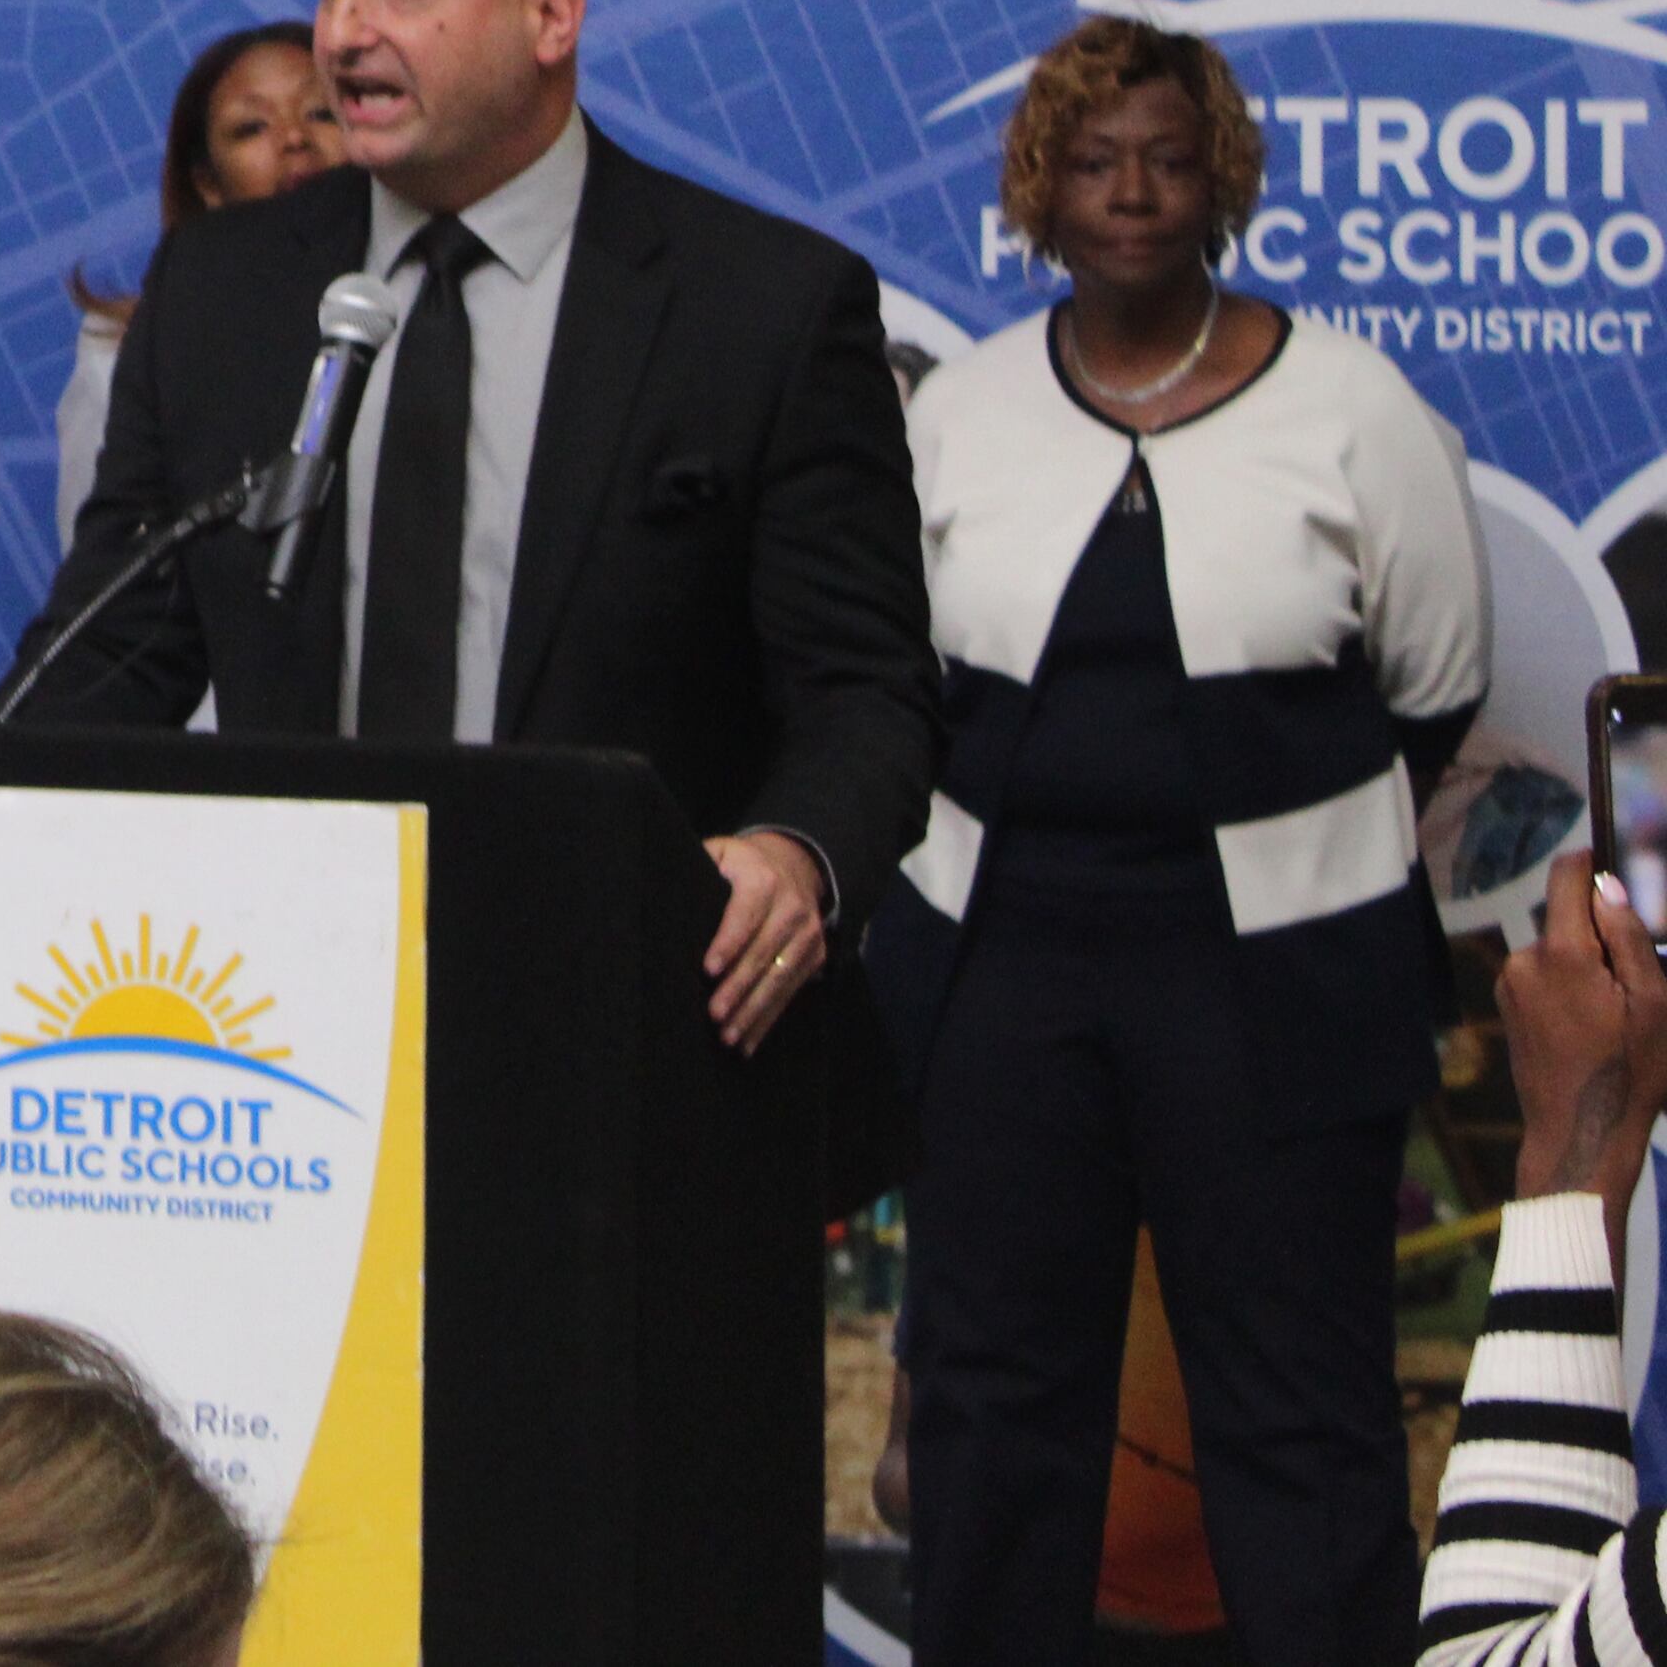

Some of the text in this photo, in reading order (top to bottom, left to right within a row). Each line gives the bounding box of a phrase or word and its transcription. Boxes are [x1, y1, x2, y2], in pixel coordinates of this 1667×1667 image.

[1245, 94, 1649, 202] TROIT
[1435, 306, 1653, 355] DISTRICT
[11, 1086, 273, 1147] DETROIT
[120, 1146, 331, 1194] SCHOOLS
[10, 1188, 274, 1223] COMMUNITY DISTRICT
[194, 1402, 280, 1442] Rise.
